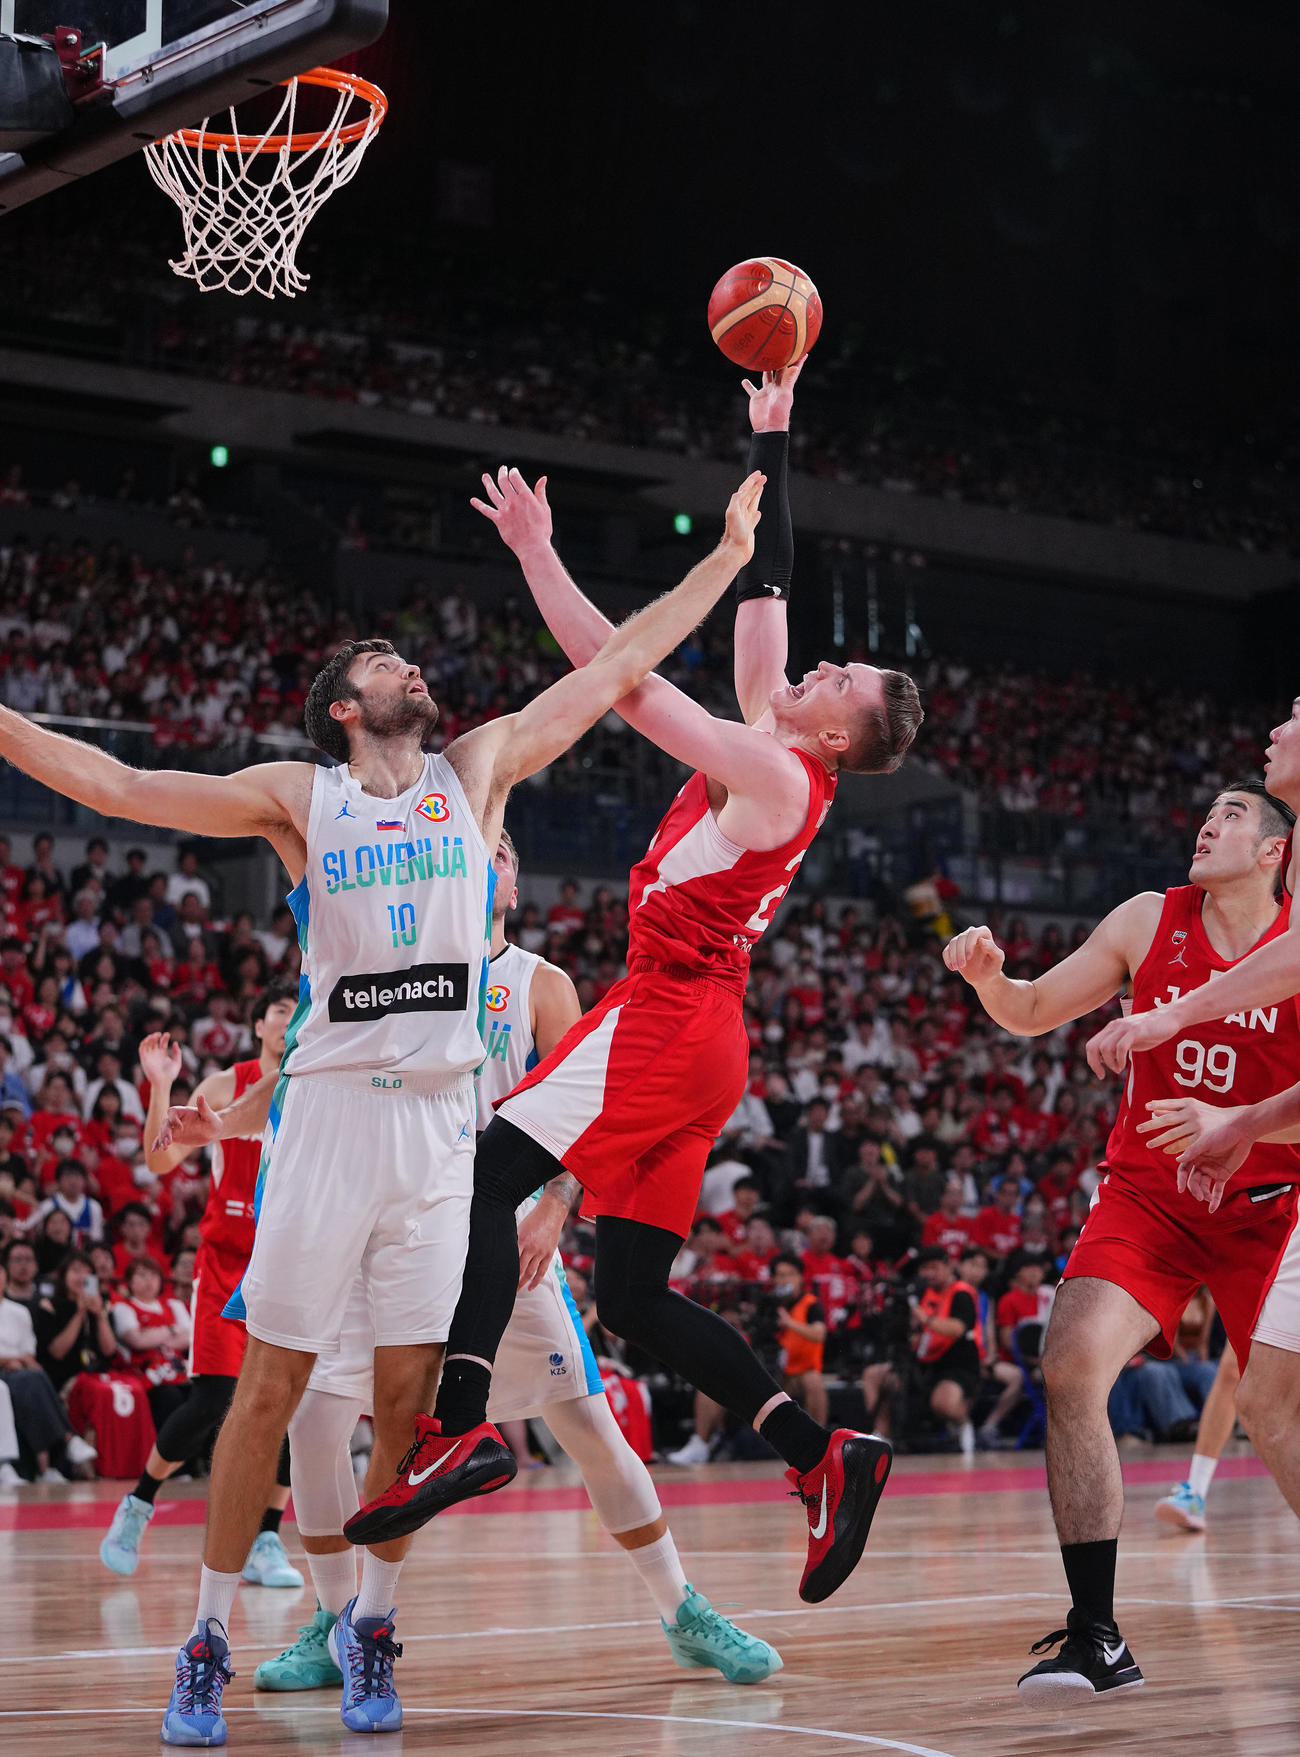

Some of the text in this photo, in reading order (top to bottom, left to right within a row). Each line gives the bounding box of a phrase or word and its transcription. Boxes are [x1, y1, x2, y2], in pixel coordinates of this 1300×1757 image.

[322, 836, 468, 895] SLOVENIJA
[387, 903, 417, 948] 10
[343, 975, 454, 1009] telemach
[1153, 985, 1279, 1034] JAN
[371, 1077, 402, 1089] SLO
[1173, 1039, 1237, 1094] 99
[550, 1366, 567, 1376] KZS
